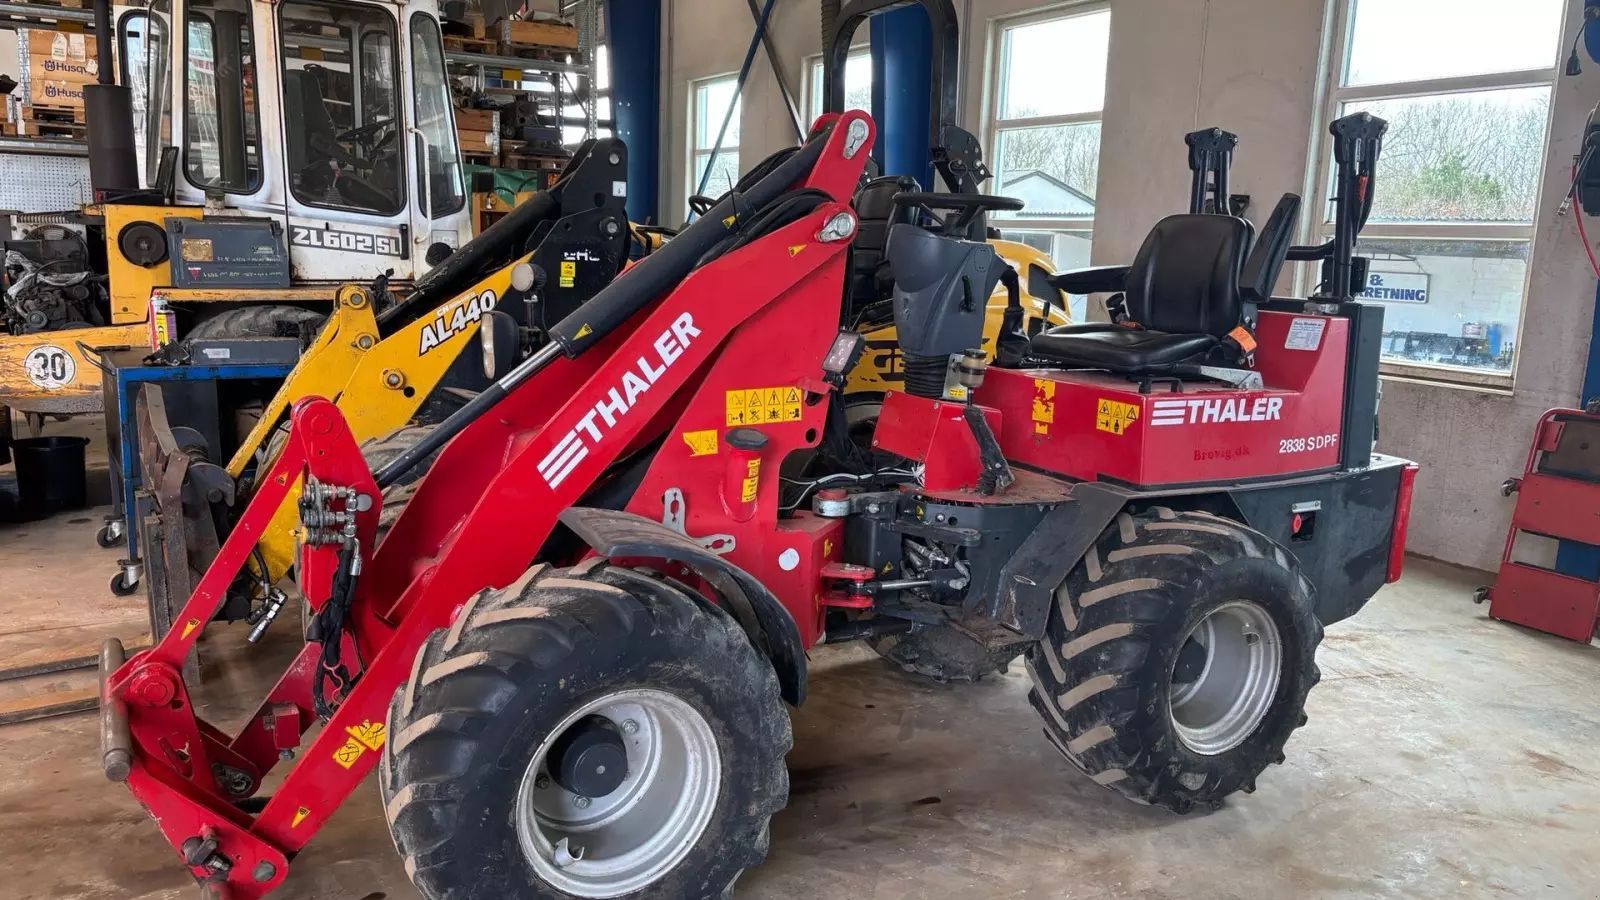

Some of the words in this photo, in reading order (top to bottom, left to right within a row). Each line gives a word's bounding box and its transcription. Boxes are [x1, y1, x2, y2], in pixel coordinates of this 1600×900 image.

[1369, 274, 1383, 286] &
[419, 289, 497, 357] AL440
[34, 352, 66, 381] 30
[575, 312, 702, 443] THALER
[1187, 397, 1283, 424] THALER
[1279, 438, 1306, 454] 2838
